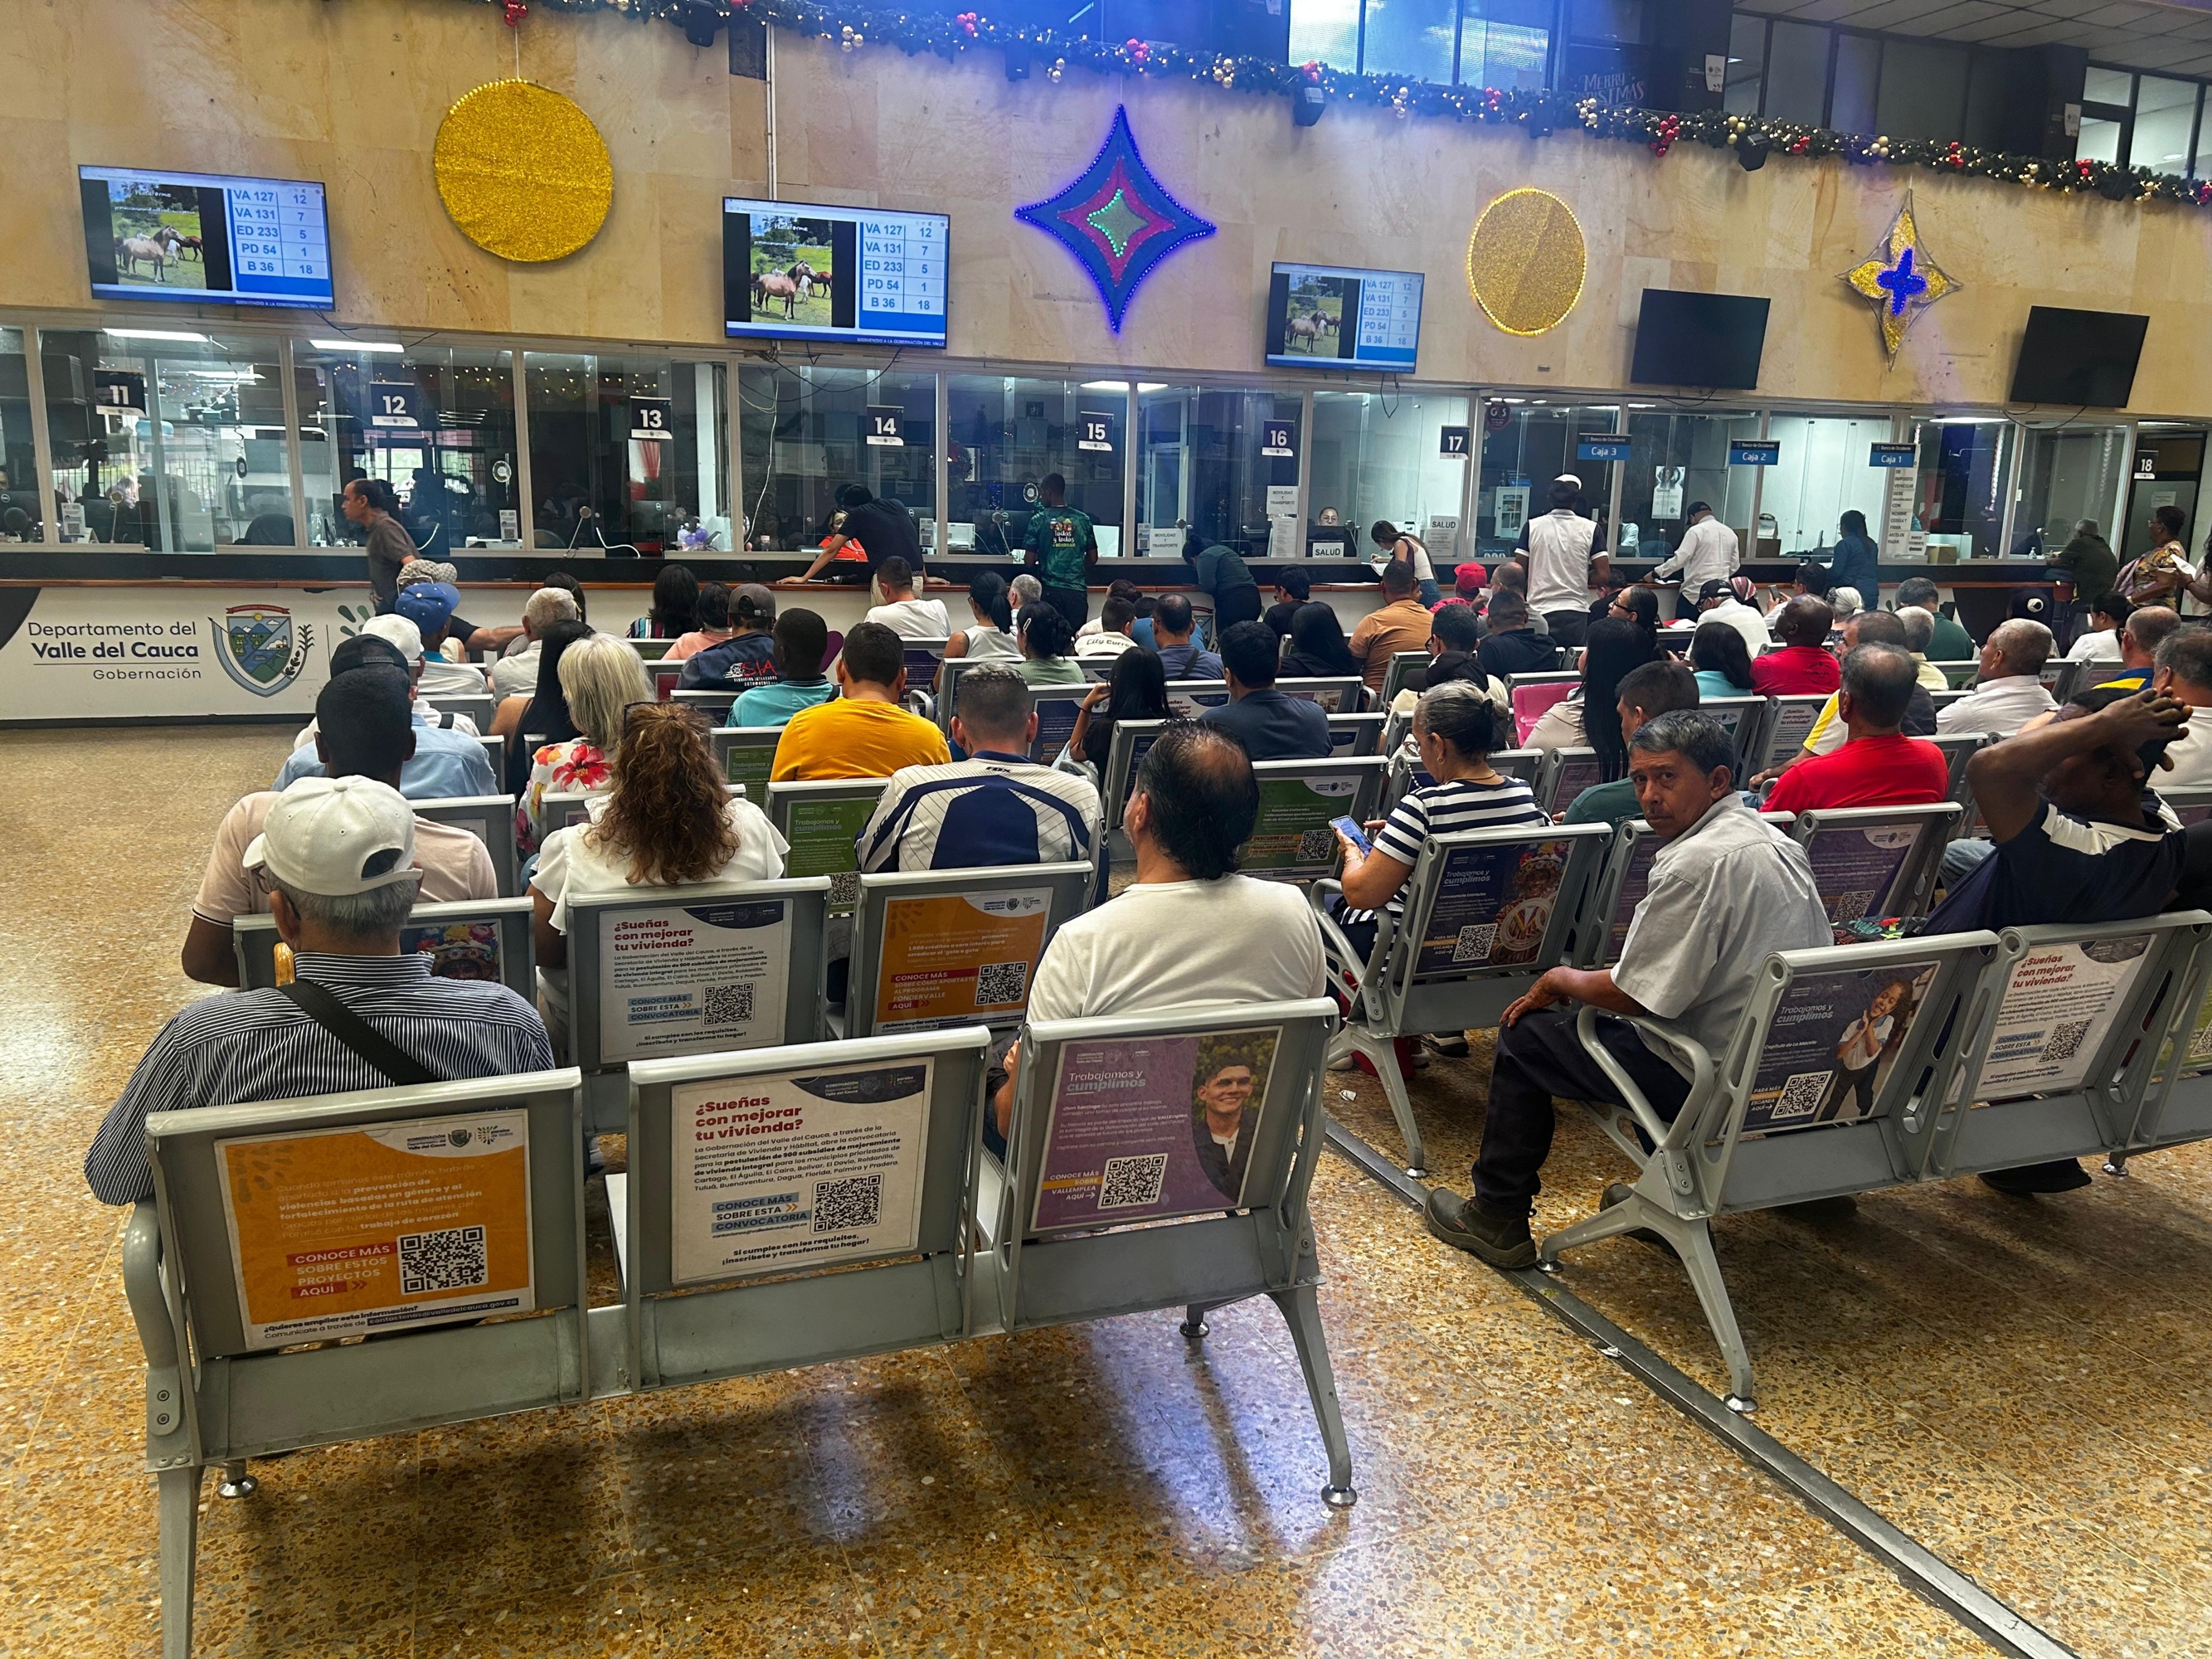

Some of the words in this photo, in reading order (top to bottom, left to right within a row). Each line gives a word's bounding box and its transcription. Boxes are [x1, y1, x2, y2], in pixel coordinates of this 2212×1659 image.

[1579, 72, 1625, 91] MERRY
[234, 190, 250, 202] VA
[254, 192, 274, 202] 127
[293, 194, 307, 204] 12
[236, 207, 252, 219] VA
[255, 209, 275, 220] 131
[298, 212, 304, 221] 7
[237, 226, 254, 236] ED
[257, 227, 278, 237] 233
[299, 230, 306, 240] 5
[865, 223, 881, 234] VA
[884, 225, 902, 236] 127
[920, 227, 931, 237] 12
[242, 244, 259, 254] PD
[262, 245, 276, 255] 54
[301, 247, 306, 256] 1
[865, 241, 880, 252] VA
[884, 243, 901, 254] 131
[921, 246, 928, 255] 7
[248, 261, 256, 271] B
[260, 262, 274, 272] 36
[299, 265, 313, 275] 18
[865, 260, 880, 270] ED
[884, 262, 902, 272] 233
[921, 264, 928, 274] 5
[868, 279, 883, 289] PD
[886, 280, 899, 289] 54
[921, 283, 926, 291] 1
[1367, 280, 1377, 289] VA
[1378, 281, 1391, 289] 127
[872, 297, 879, 306] B
[882, 298, 895, 308] 36
[918, 300, 930, 309] 18
[109, 385, 129, 405] 11
[382, 396, 406, 414] 12
[640, 409, 662, 428] 13
[875, 417, 896, 435] 14
[1087, 423, 1106, 440] 15
[1270, 430, 1287, 446] 16
[1448, 435, 1463, 451] 17
[1591, 447, 1608, 457] Caja
[1743, 452, 1758, 462] Caja
[1760, 453, 1767, 461] 2
[1881, 455, 1896, 464] Caja
[2141, 459, 2153, 471] 18
[1432, 521, 1456, 529] SALUD
[28, 621, 164, 639] Departamento
[169, 620, 197, 636] del
[31, 642, 86, 659] Valle
[92, 642, 125, 659] del
[131, 641, 199, 658] Cauca
[93, 667, 202, 680] Gobernación
[1444, 875, 1491, 885] cumplimos
[615, 919, 669, 932] ¿Sueñas
[641, 929, 693, 940] mejorar
[630, 938, 694, 950] vivienda?
[2021, 954, 2064, 968] ¿Sueñas
[931, 971, 948, 979] MÁS
[2017, 968, 2035, 977] con
[2037, 964, 2076, 975] mejorar
[938, 976, 975, 985] APORTASTE
[2025, 974, 2073, 987] vivienda?
[631, 995, 667, 1005] CONOCE
[668, 994, 688, 1002] MÁS
[893, 992, 946, 1001] FONDERVALLE
[892, 1001, 912, 1010] AQUÍ
[1781, 1004, 1826, 1014] Trabajamos
[631, 1009, 699, 1020] CONVOCATORIA
[1777, 1011, 1833, 1024] cumplimos
[1998, 1034, 2027, 1044] CONOCE
[1991, 1047, 2042, 1059] CONVOCATORIA
[1994, 1042, 2015, 1051] SOBRE
[1069, 1071, 1134, 1082] Trabajamos
[1135, 1070, 1143, 1078] y
[1067, 1078, 1146, 1092] cumplimos
[695, 1097, 770, 1116] ¿Sueñas
[696, 1116, 728, 1127] con
[732, 1107, 802, 1123] mejorar
[695, 1131, 714, 1141] tu
[717, 1119, 803, 1138] vivienda?
[1052, 1185, 1096, 1194] VALLEMPLEA
[717, 1199, 766, 1211] CONOCE
[767, 1194, 792, 1206] MÁS
[716, 1209, 752, 1220] SOBRE
[755, 1206, 781, 1216] ESTA
[716, 1213, 807, 1231] CONVOCATORIA
[295, 1249, 356, 1264] CONOCE
[359, 1245, 390, 1256] MÁS
[297, 1262, 341, 1275] SOBRE
[345, 1257, 387, 1269] ESTOS
[298, 1268, 380, 1286] PROYECTOS
[300, 1283, 334, 1297] AQUÍ
